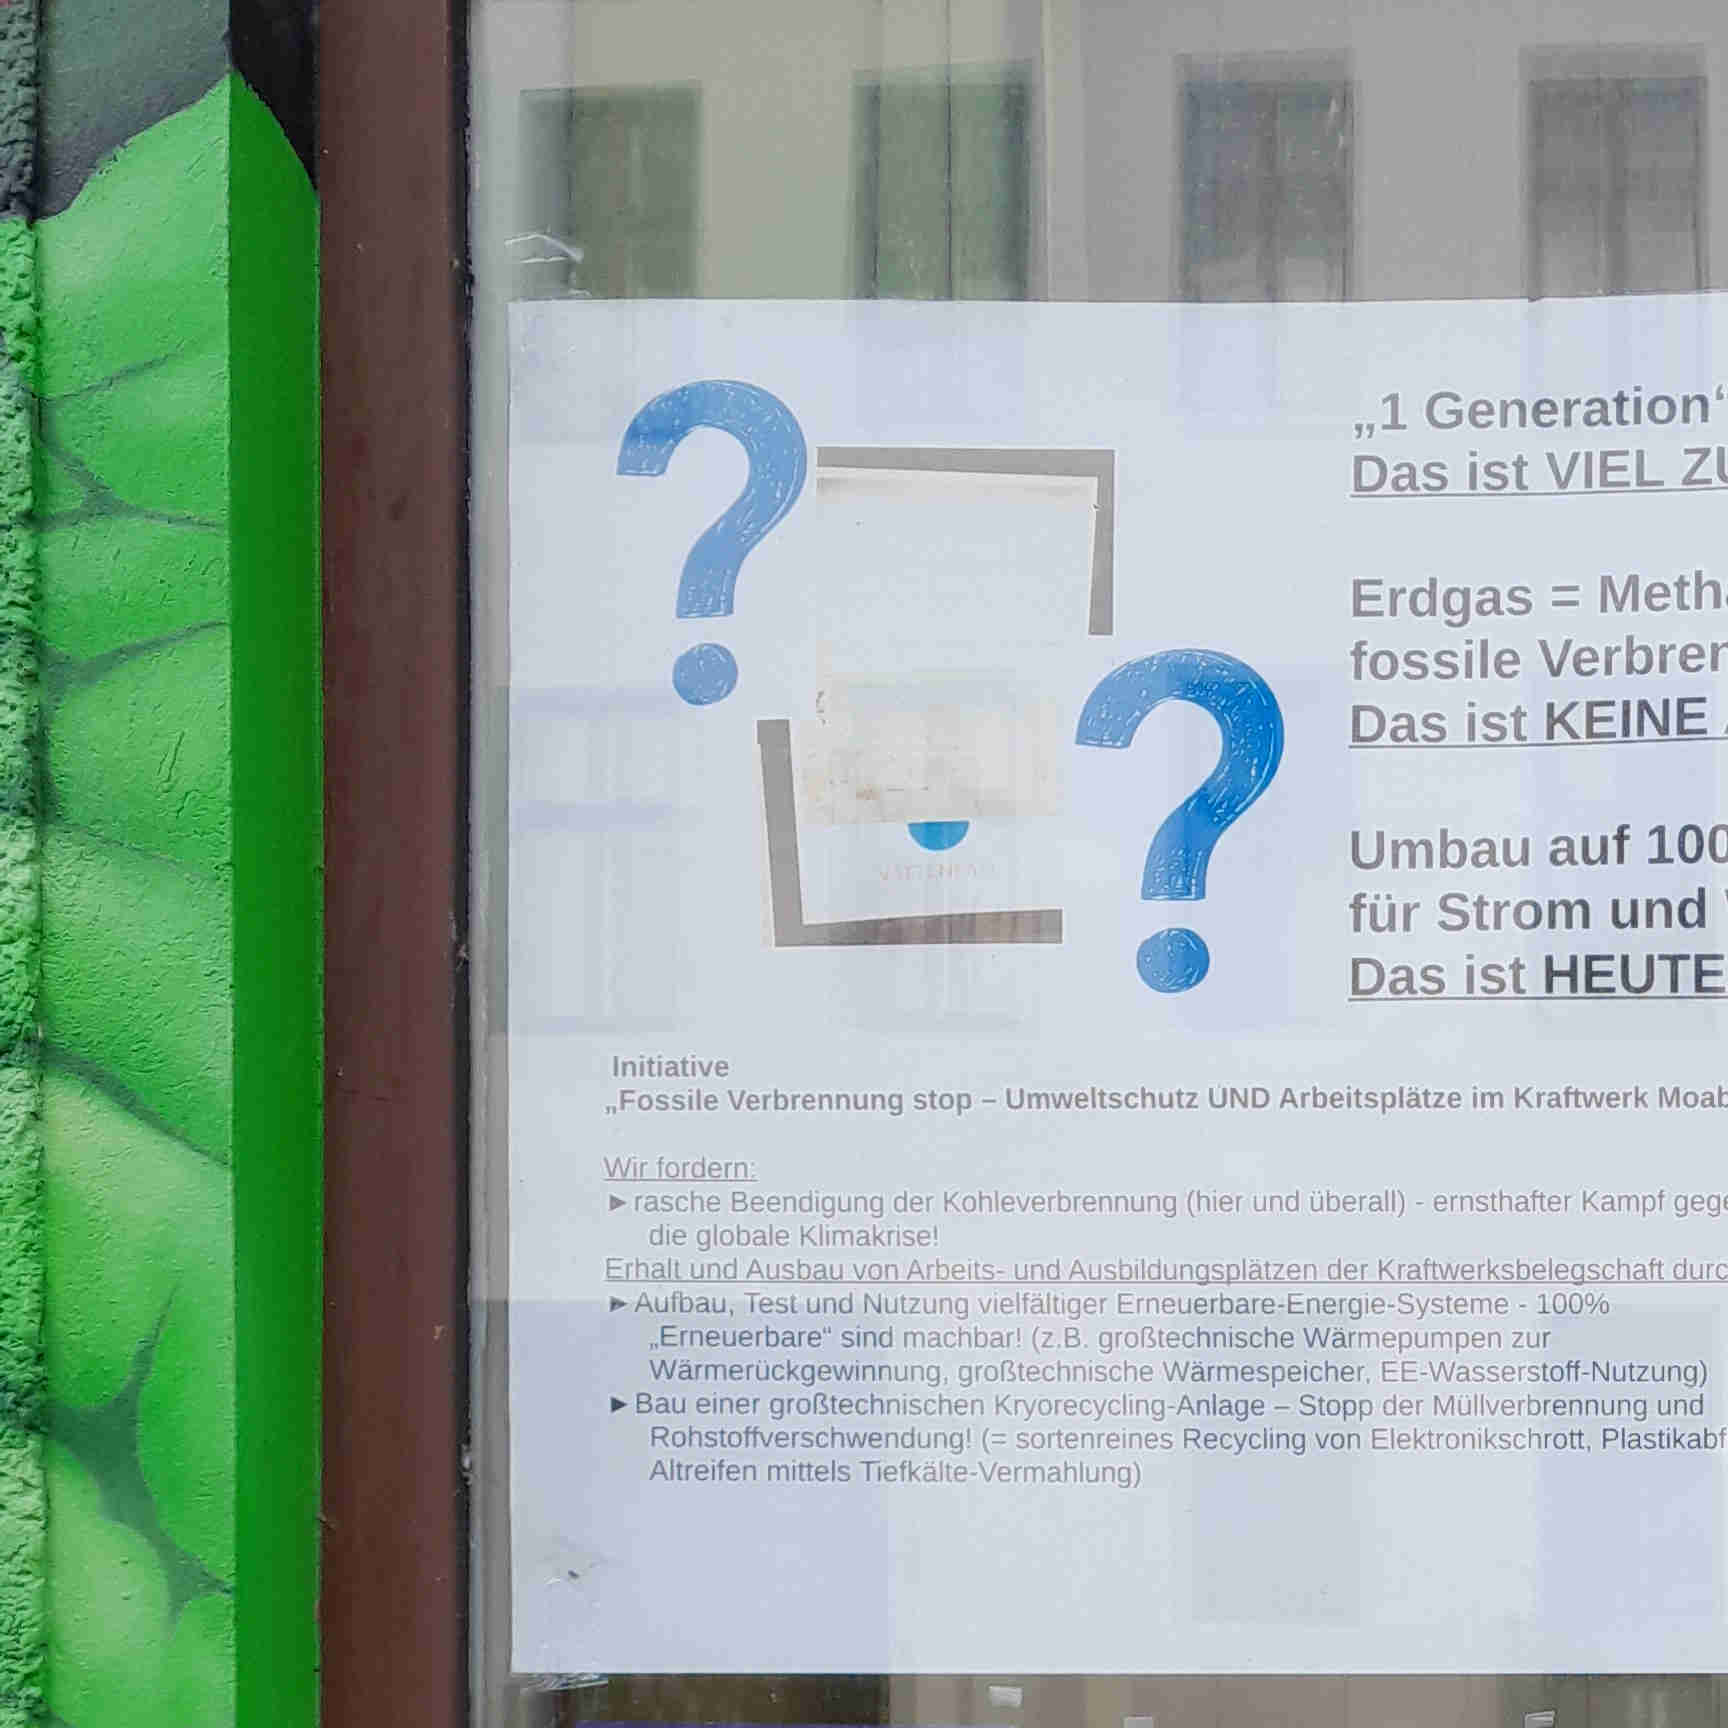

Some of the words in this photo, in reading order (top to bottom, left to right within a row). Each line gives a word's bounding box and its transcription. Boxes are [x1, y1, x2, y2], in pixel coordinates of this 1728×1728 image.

[1354, 393, 1408, 440] „1
[1353, 454, 1449, 493] Das
[1468, 450, 1529, 491] ist
[1544, 448, 1665, 488] VIEL
[1352, 576, 1533, 629] Erdgas
[1551, 584, 1580, 607] =
[1350, 638, 1521, 681] fossile
[1351, 704, 1447, 741] Das
[1467, 701, 1528, 739] ist
[1545, 696, 1708, 738] KEINE
[1351, 828, 1530, 871] Umbau
[1548, 823, 1631, 867] auf
[1348, 892, 1421, 933] für
[1437, 892, 1591, 932] Strom
[1611, 886, 1706, 930] und
[1351, 957, 1446, 996] Das
[1466, 953, 1527, 995] ist
[1544, 953, 1726, 995] HEUTE
[613, 1054, 729, 1078] Initiative
[605, 1088, 719, 1115] „Fossile
[727, 1088, 904, 1117] Verbrennung
[913, 1089, 972, 1117] stop
[1005, 1086, 1199, 1110] Umweltschutz
[1208, 1086, 1271, 1109] UND
[1279, 1085, 1462, 1115] Arbeitsplätze
[1472, 1085, 1505, 1109] im
[1514, 1085, 1649, 1109] Kraftwerk
[603, 1155, 649, 1179] Wir
[655, 1156, 756, 1179] fordern:
[634, 1189, 721, 1217] rasche
[731, 1190, 884, 1220] Beendigung
[893, 1190, 935, 1214] der
[943, 1189, 1177, 1219] Kohleverbrennung
[1186, 1189, 1243, 1218] (hier
[1253, 1189, 1300, 1213] und
[1309, 1189, 1406, 1218] überall)
[1432, 1189, 1573, 1213] ernsthafter
[1582, 1188, 1666, 1218] Kampf
[647, 1223, 688, 1249] die
[695, 1223, 790, 1253] globale
[799, 1222, 938, 1247] Klimakrise!
[649, 1324, 832, 1350] „Erneuerbare“
[840, 1324, 894, 1349] sind
[903, 1325, 1021, 1349] machbar!
[1031, 1326, 1089, 1355] (z.B.
[1098, 1325, 1295, 1355] großtechnische
[1302, 1326, 1502, 1355] Wärmepumpen
[1511, 1331, 1552, 1349] zur
[649, 1457, 757, 1482] Altreifen
[767, 1458, 851, 1483] mittels
[858, 1459, 1141, 1489] Tiefkälte-Vermahlung)
